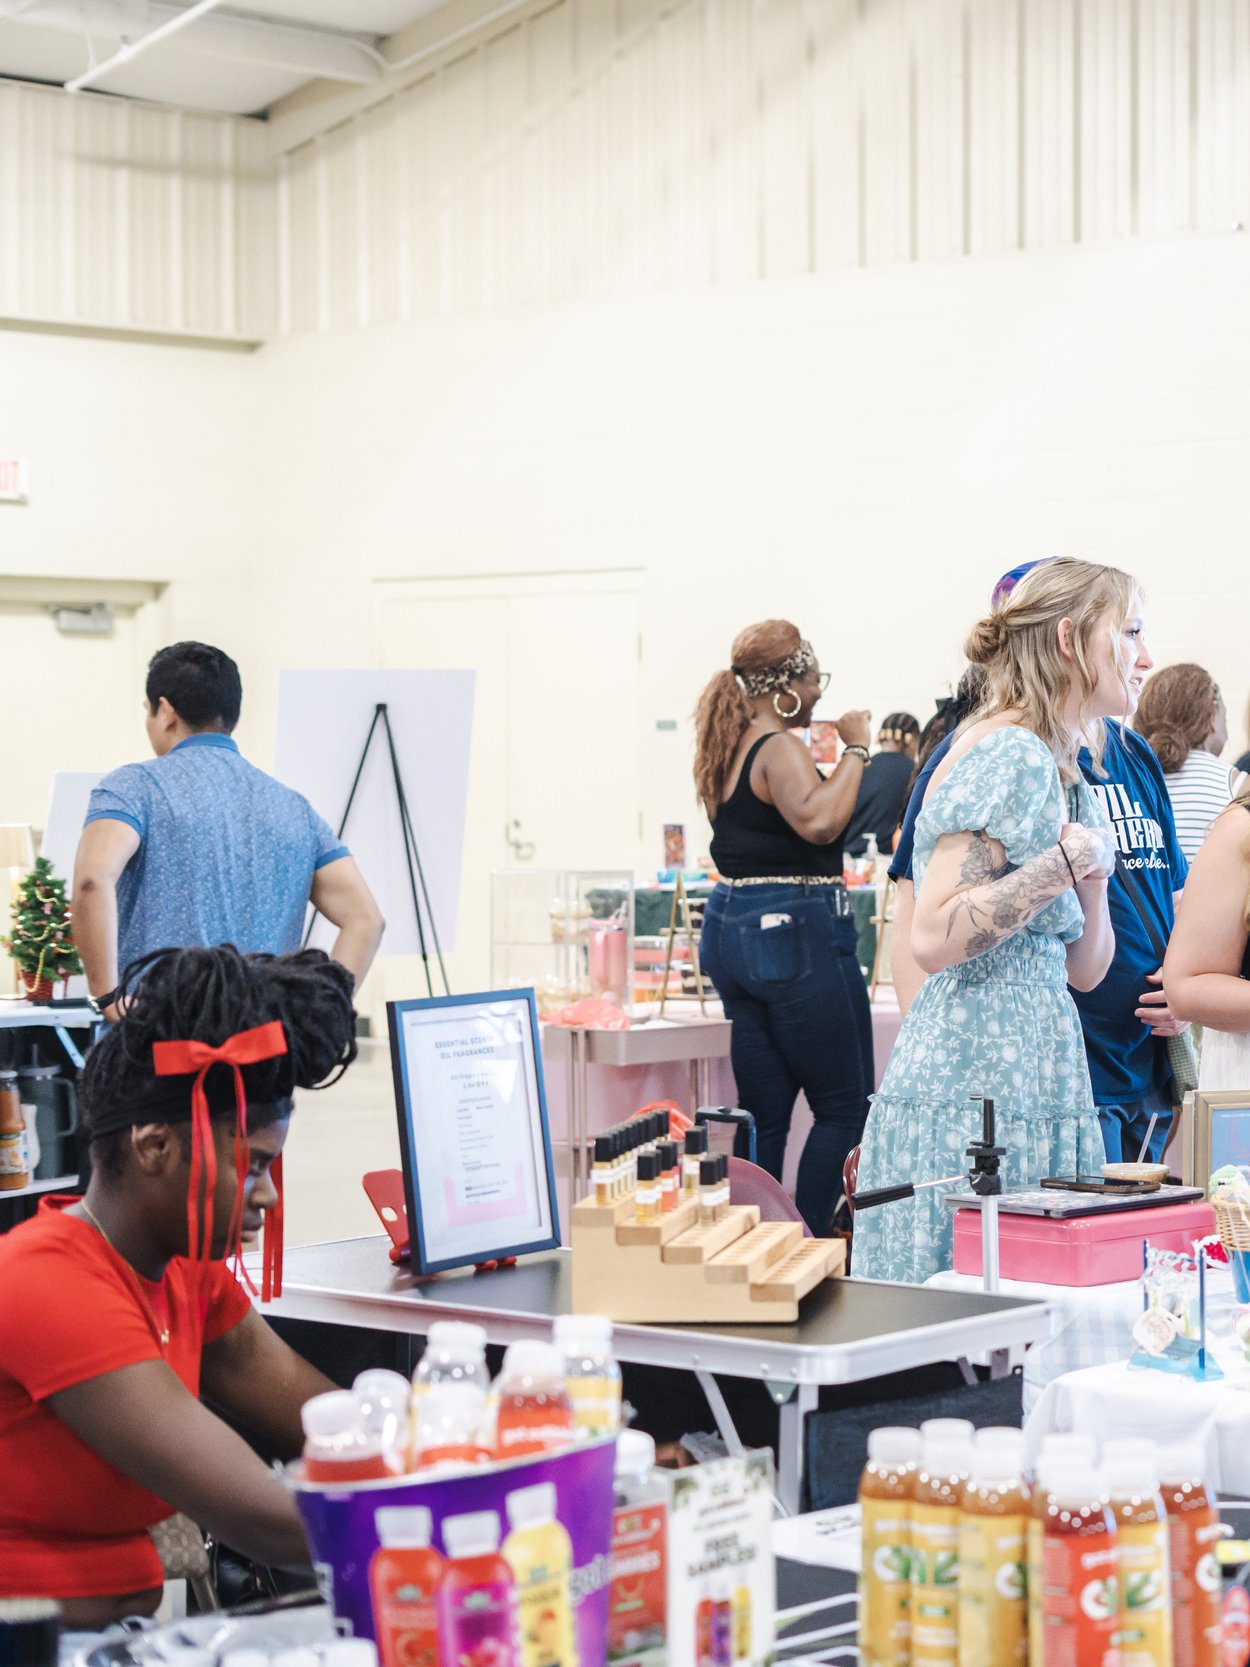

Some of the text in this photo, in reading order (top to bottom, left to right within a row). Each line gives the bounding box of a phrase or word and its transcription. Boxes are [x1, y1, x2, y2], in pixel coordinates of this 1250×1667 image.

[0, 460, 19, 492] IT
[434, 1039, 469, 1049] ESSENTIAL
[453, 1047, 495, 1057] FRAGRANCES
